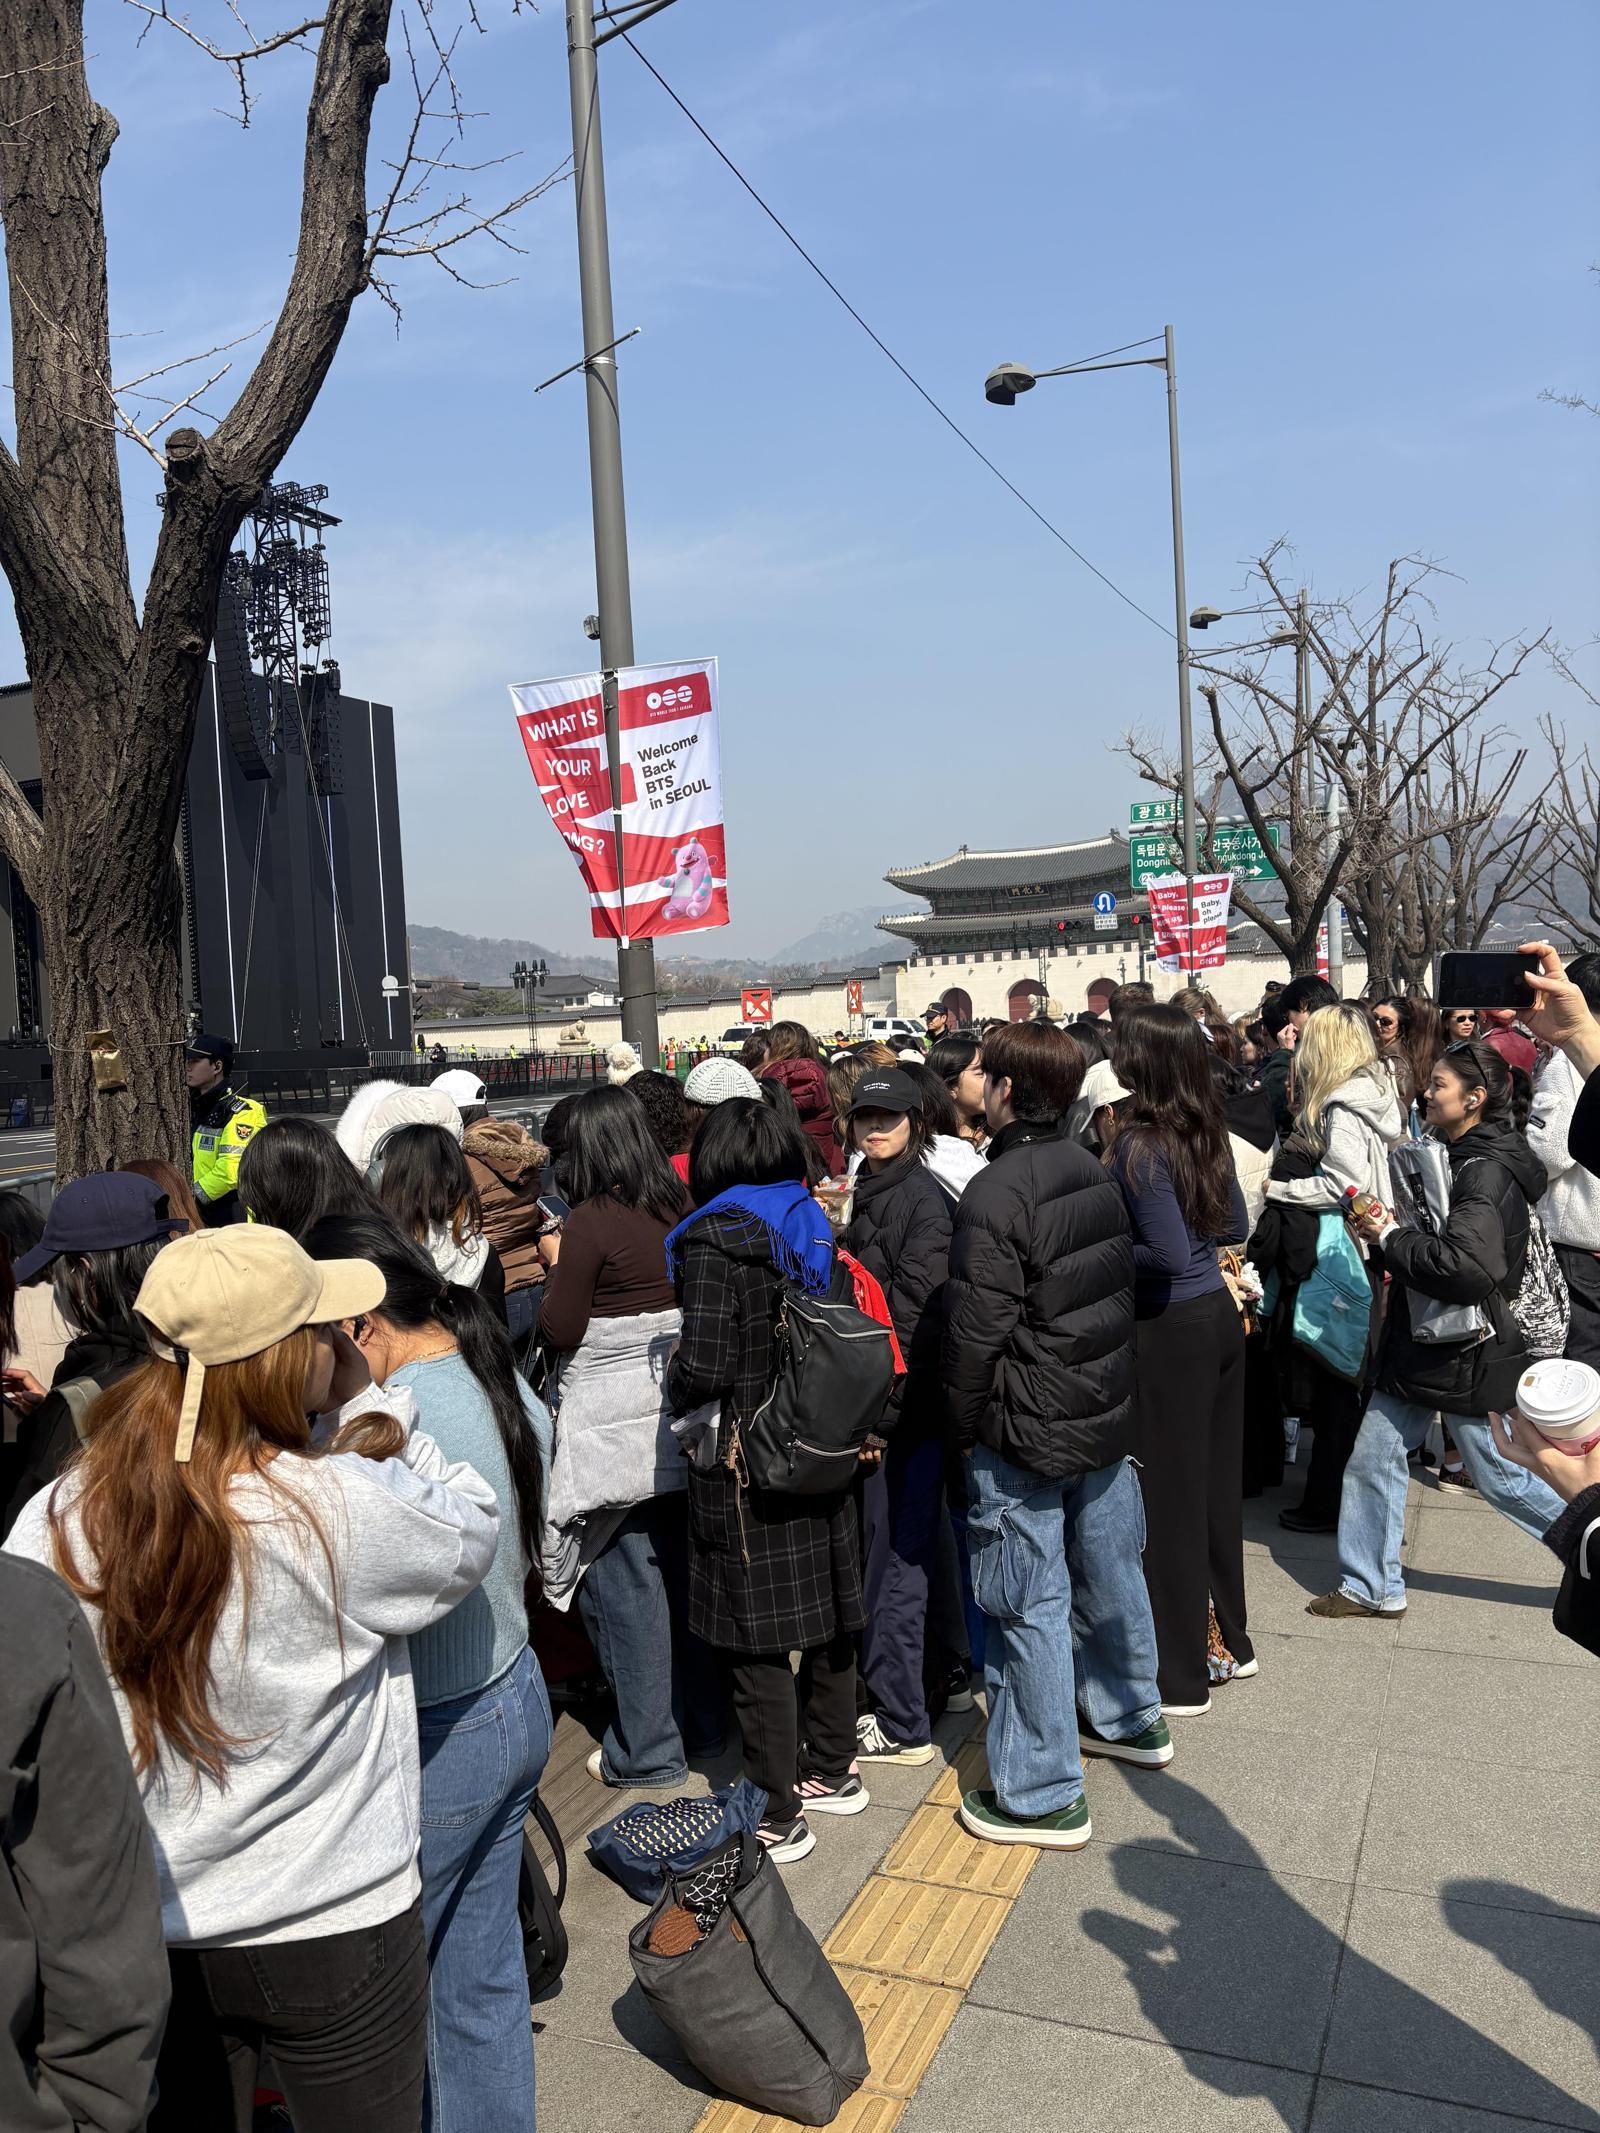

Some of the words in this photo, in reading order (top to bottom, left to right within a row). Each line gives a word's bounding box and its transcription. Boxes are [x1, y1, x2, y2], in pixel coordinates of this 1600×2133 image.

[526, 715, 577, 742] WHAT
[582, 708, 599, 727] IS
[637, 733, 699, 763] Welcome
[545, 759, 592, 777] YOUR
[642, 758, 677, 778] Back
[645, 778, 674, 794] BTS
[649, 795, 663, 810] in
[665, 778, 712, 805] SEOUL
[547, 790, 590, 818] LOVE
[1212, 836, 1261, 852] 안국동사거
[1214, 851, 1257, 864] ngukdong
[1233, 868, 1244, 877] 50
[1202, 908, 1212, 916] oh
